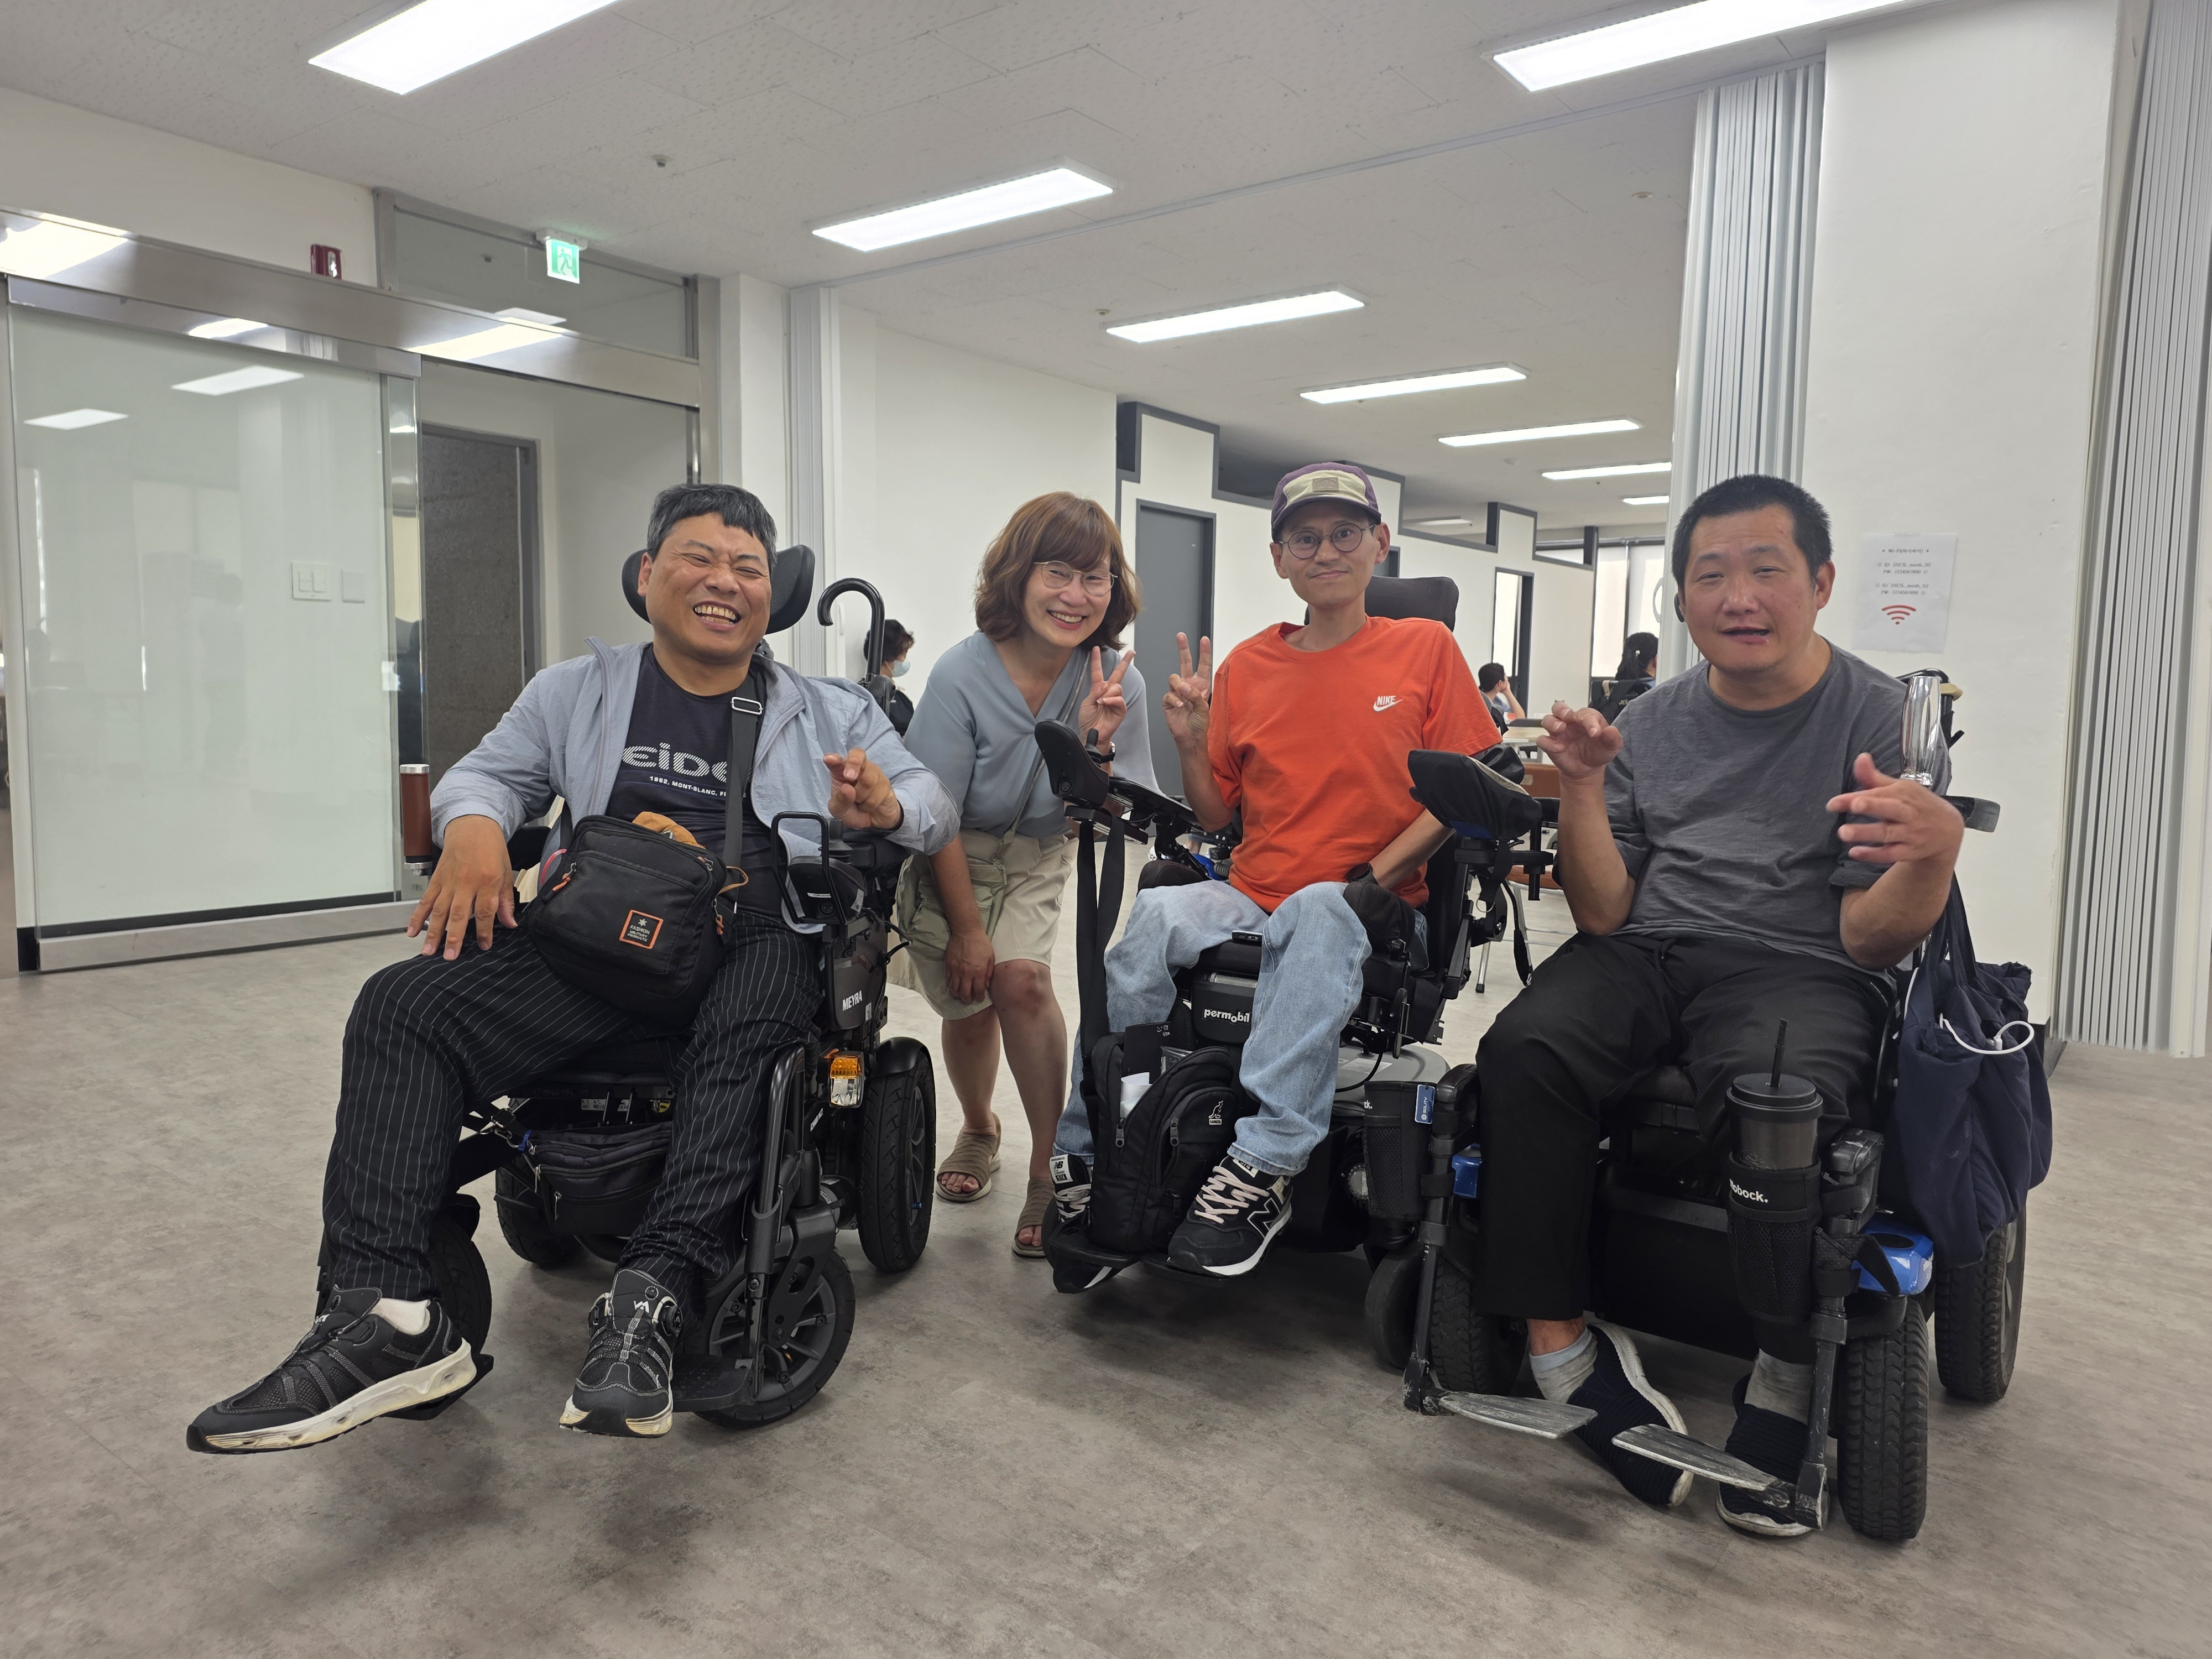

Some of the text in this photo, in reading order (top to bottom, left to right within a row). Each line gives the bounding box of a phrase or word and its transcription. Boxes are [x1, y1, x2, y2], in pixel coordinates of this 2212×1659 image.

[1376, 695, 1396, 706] NIKE
[629, 925, 650, 935] FASHION
[842, 990, 863, 1012] MEYRA
[1204, 1009, 1250, 1023] permobil
